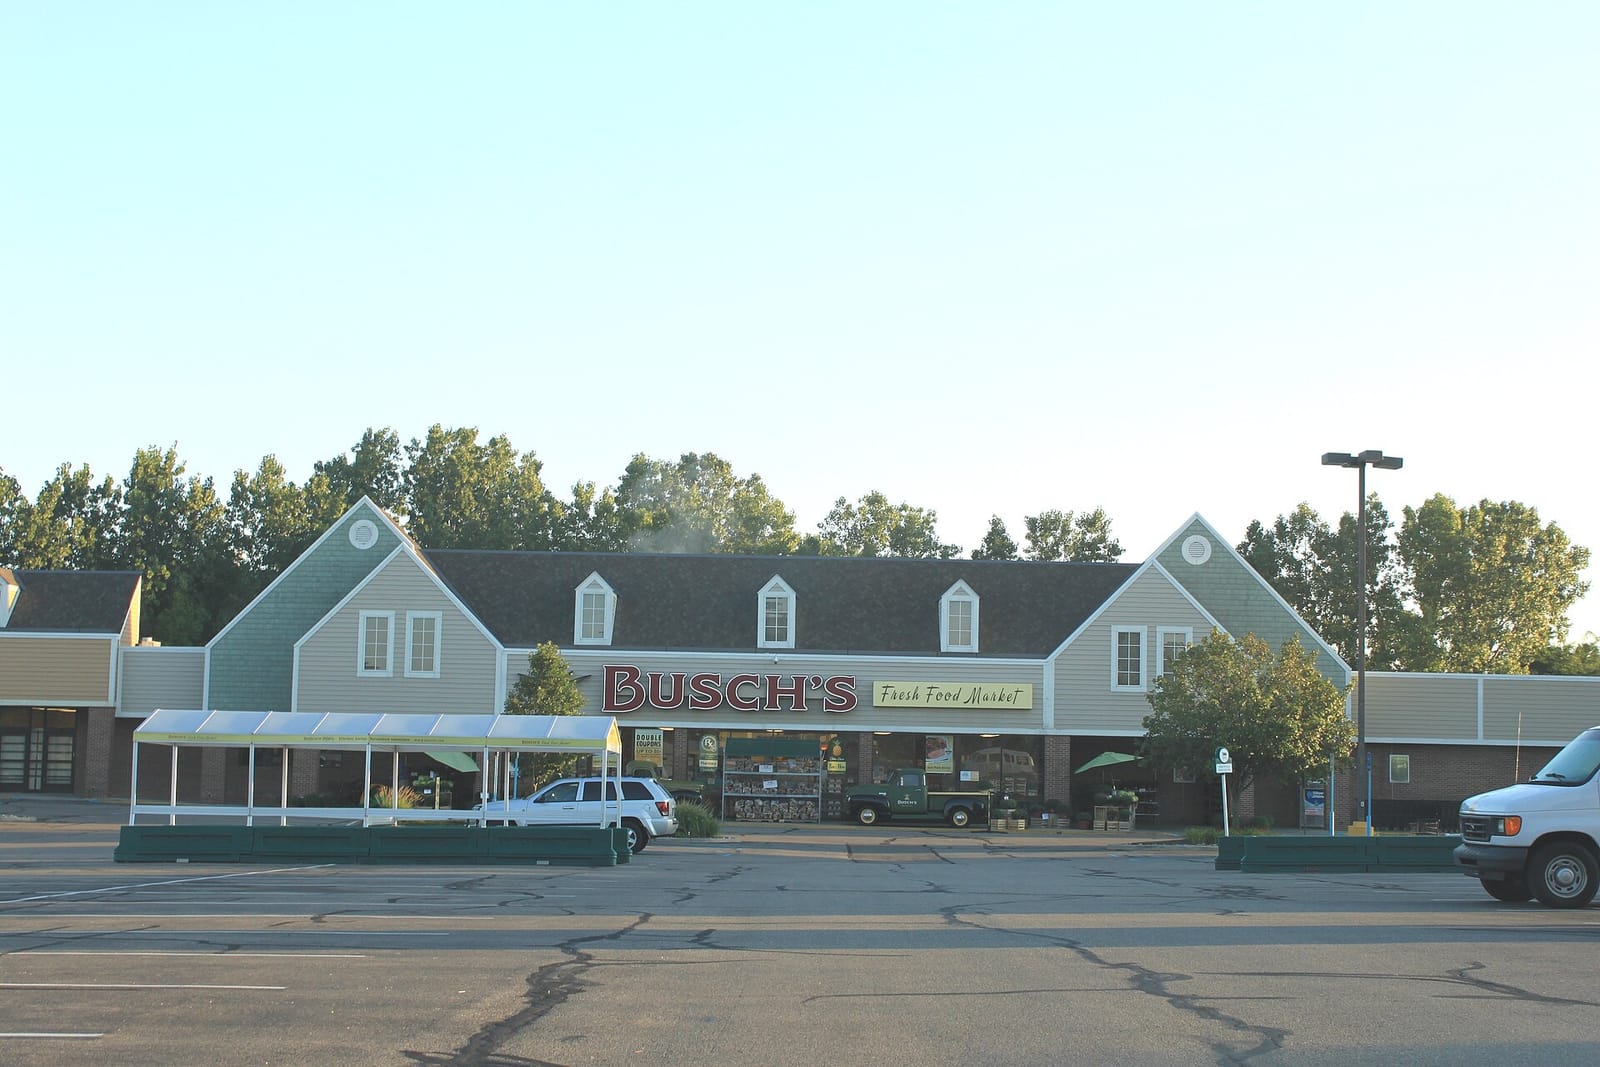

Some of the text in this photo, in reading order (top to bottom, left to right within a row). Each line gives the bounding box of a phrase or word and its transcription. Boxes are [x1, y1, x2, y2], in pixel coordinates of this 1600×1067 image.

[601, 664, 858, 713] BUSCH'S
[881, 685, 1024, 705] Fresh Food Market
